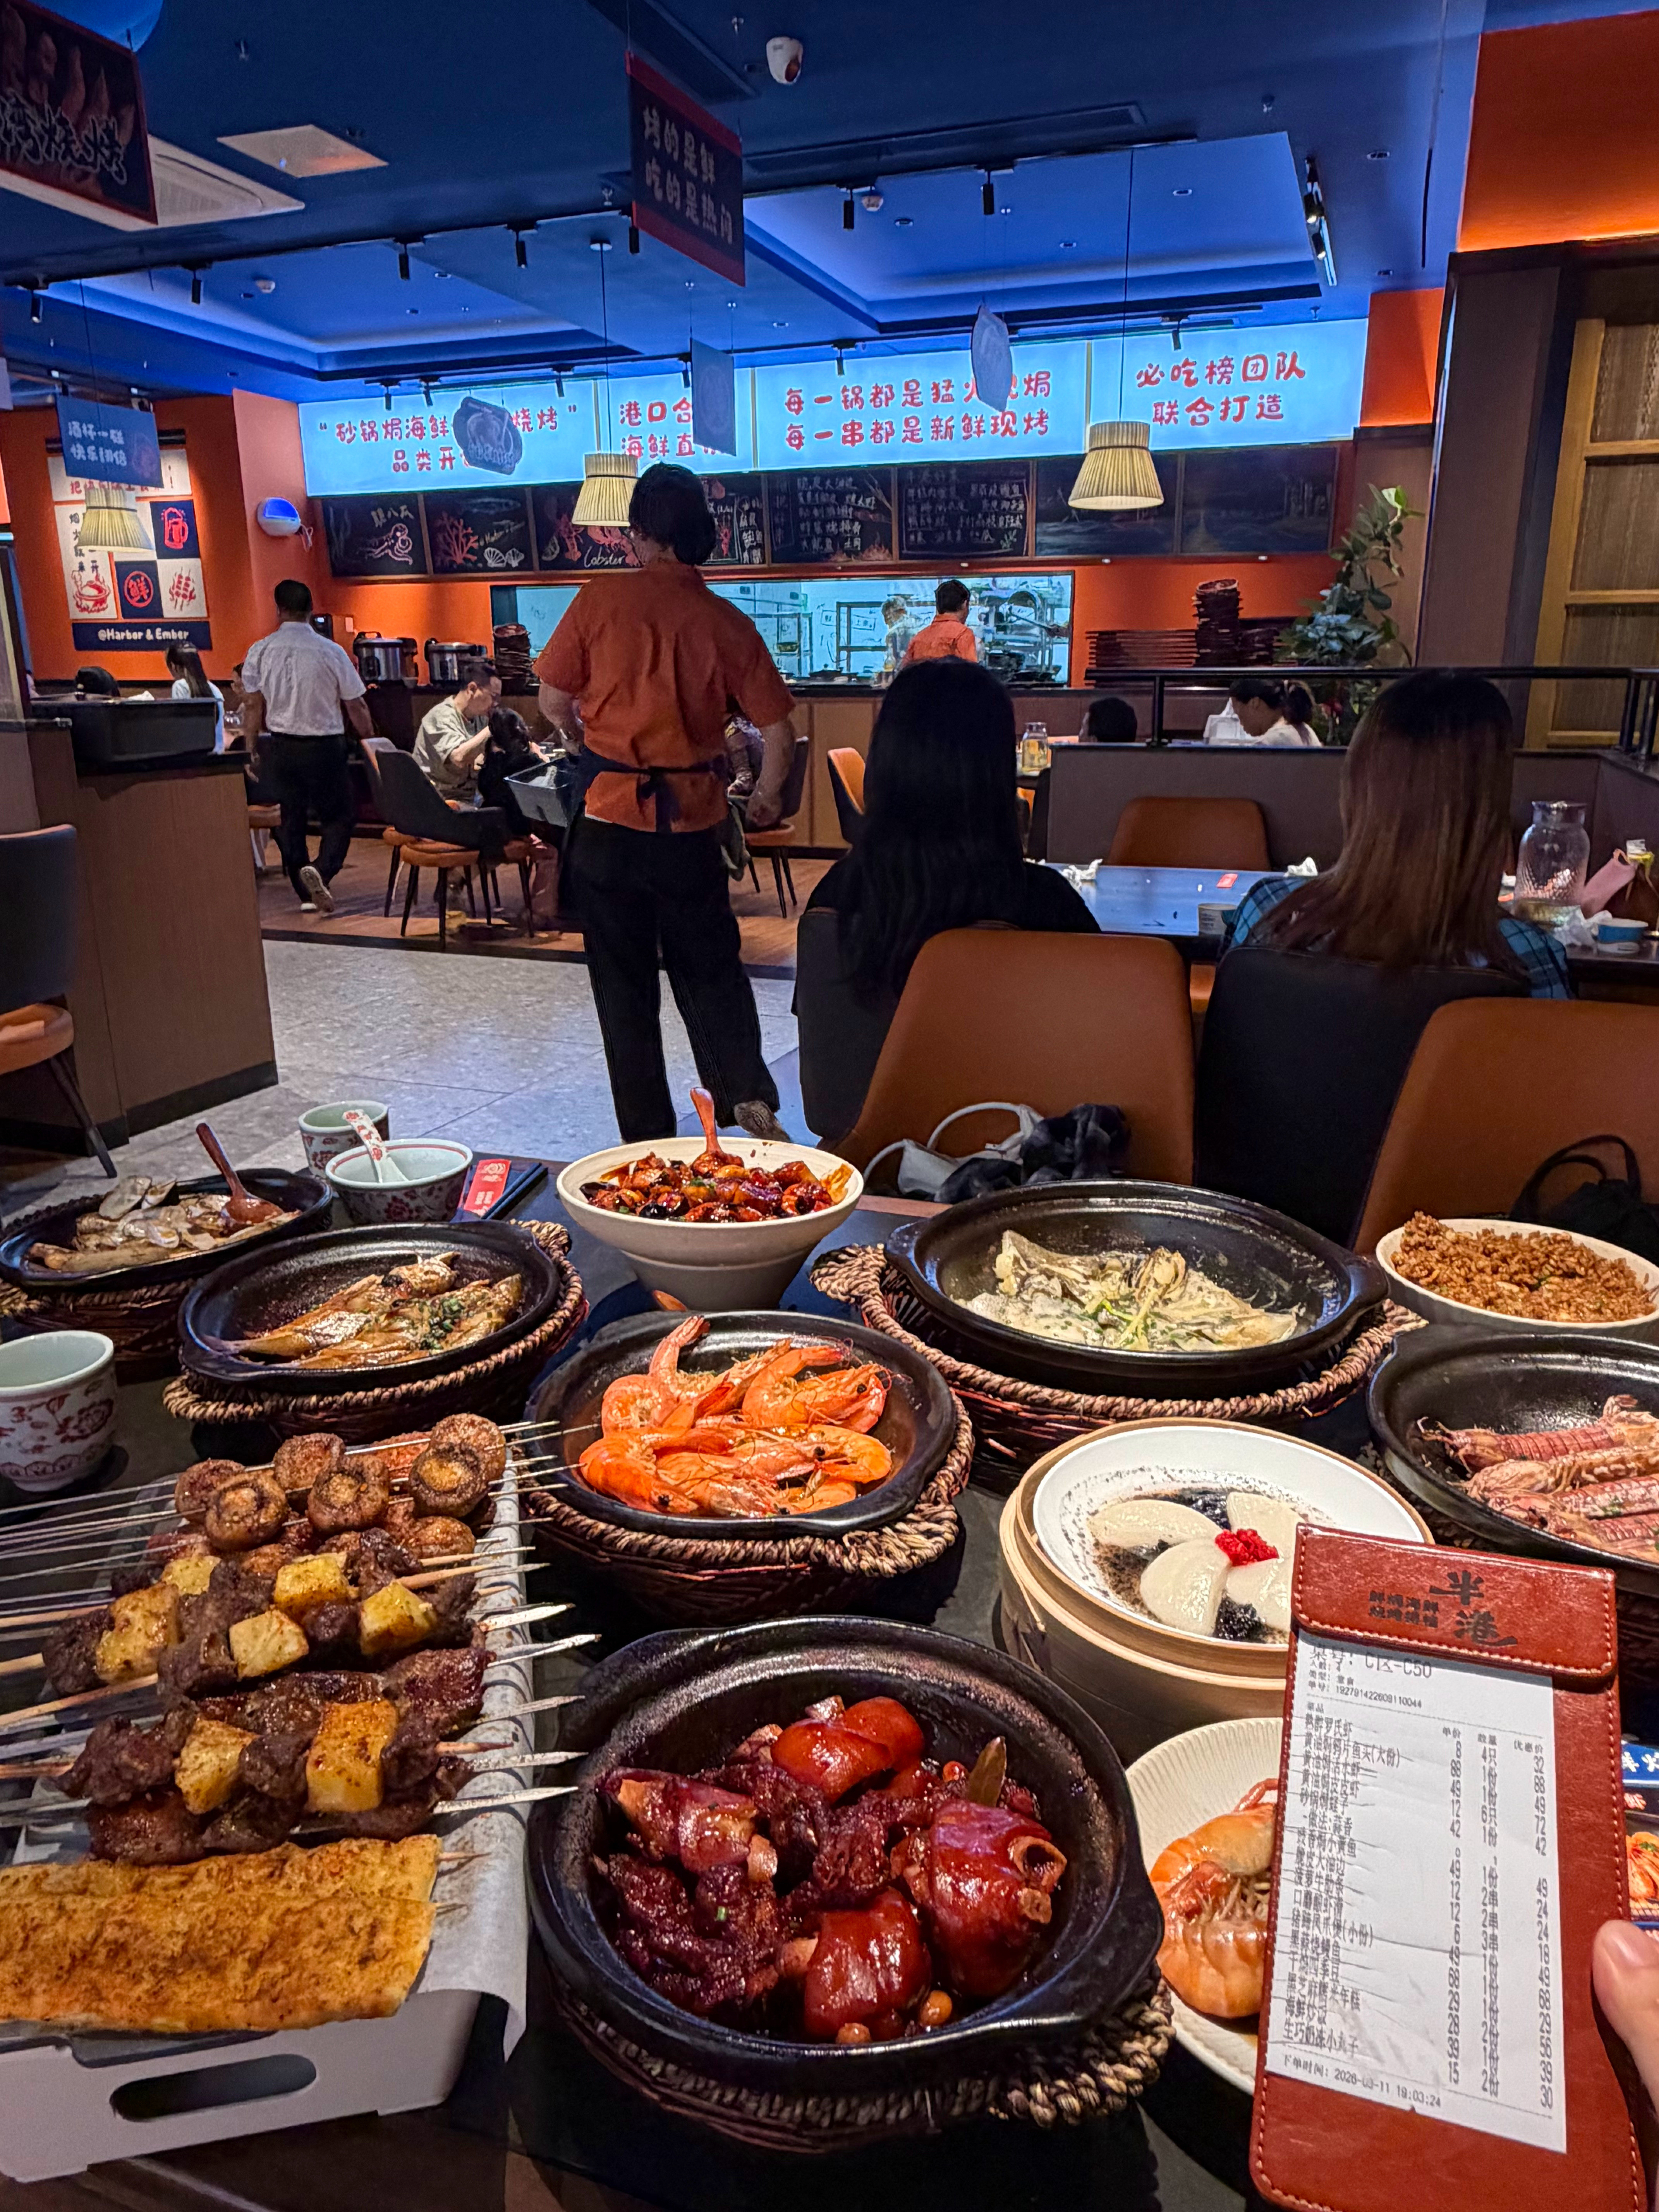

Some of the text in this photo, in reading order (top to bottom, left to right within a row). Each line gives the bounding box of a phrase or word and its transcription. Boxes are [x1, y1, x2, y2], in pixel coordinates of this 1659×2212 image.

[1137, 351, 1306, 388] 必吃榜团队
[785, 371, 1051, 415] 每一锅都是猛火焗
[1153, 394, 1283, 426] 联合打造
[622, 433, 715, 459] 海鲜直
[786, 409, 1049, 450] 每一串都是新鲜现烤
[392, 446, 471, 472] 品类开
[128, 577, 148, 600] 鲜
[98, 627, 189, 642] @Harbor & Ember
[1451, 1758, 1462, 1779] 88
[1534, 1774, 1545, 1795] 88
[1456, 1740, 1462, 1759] 8
[1534, 1755, 1545, 1774] 32
[1450, 1778, 1461, 1798] 49
[1534, 1795, 1546, 1815] 49
[1450, 1798, 1461, 1819] 12
[1535, 1815, 1546, 1836] 72
[1450, 1819, 1461, 1838] 42
[1535, 1836, 1547, 1857] 42
[1449, 1858, 1461, 1879] 49
[1536, 1877, 1547, 1898] 49
[1449, 1879, 1460, 1901] 12
[1537, 1899, 1548, 1921] 24
[1449, 1901, 1460, 1923] 12
[1537, 1920, 1549, 1943] 24
[1454, 1923, 1460, 1945] 6
[1537, 1942, 1549, 1965] 18
[1448, 1943, 1460, 1966] 49
[1538, 1964, 1550, 1988] 49
[1448, 1966, 1460, 1989] 68
[1538, 1987, 1550, 2011] 68
[1448, 1988, 1460, 2013] 29
[1539, 2011, 1551, 2035] 29
[1447, 2012, 1459, 2036] 28
[1539, 2035, 1551, 2059] 56
[1447, 2035, 1459, 2060] 39
[1540, 2059, 1552, 2084] 39
[1447, 2059, 1459, 2085] 15
[1540, 2083, 1553, 2110] 30
